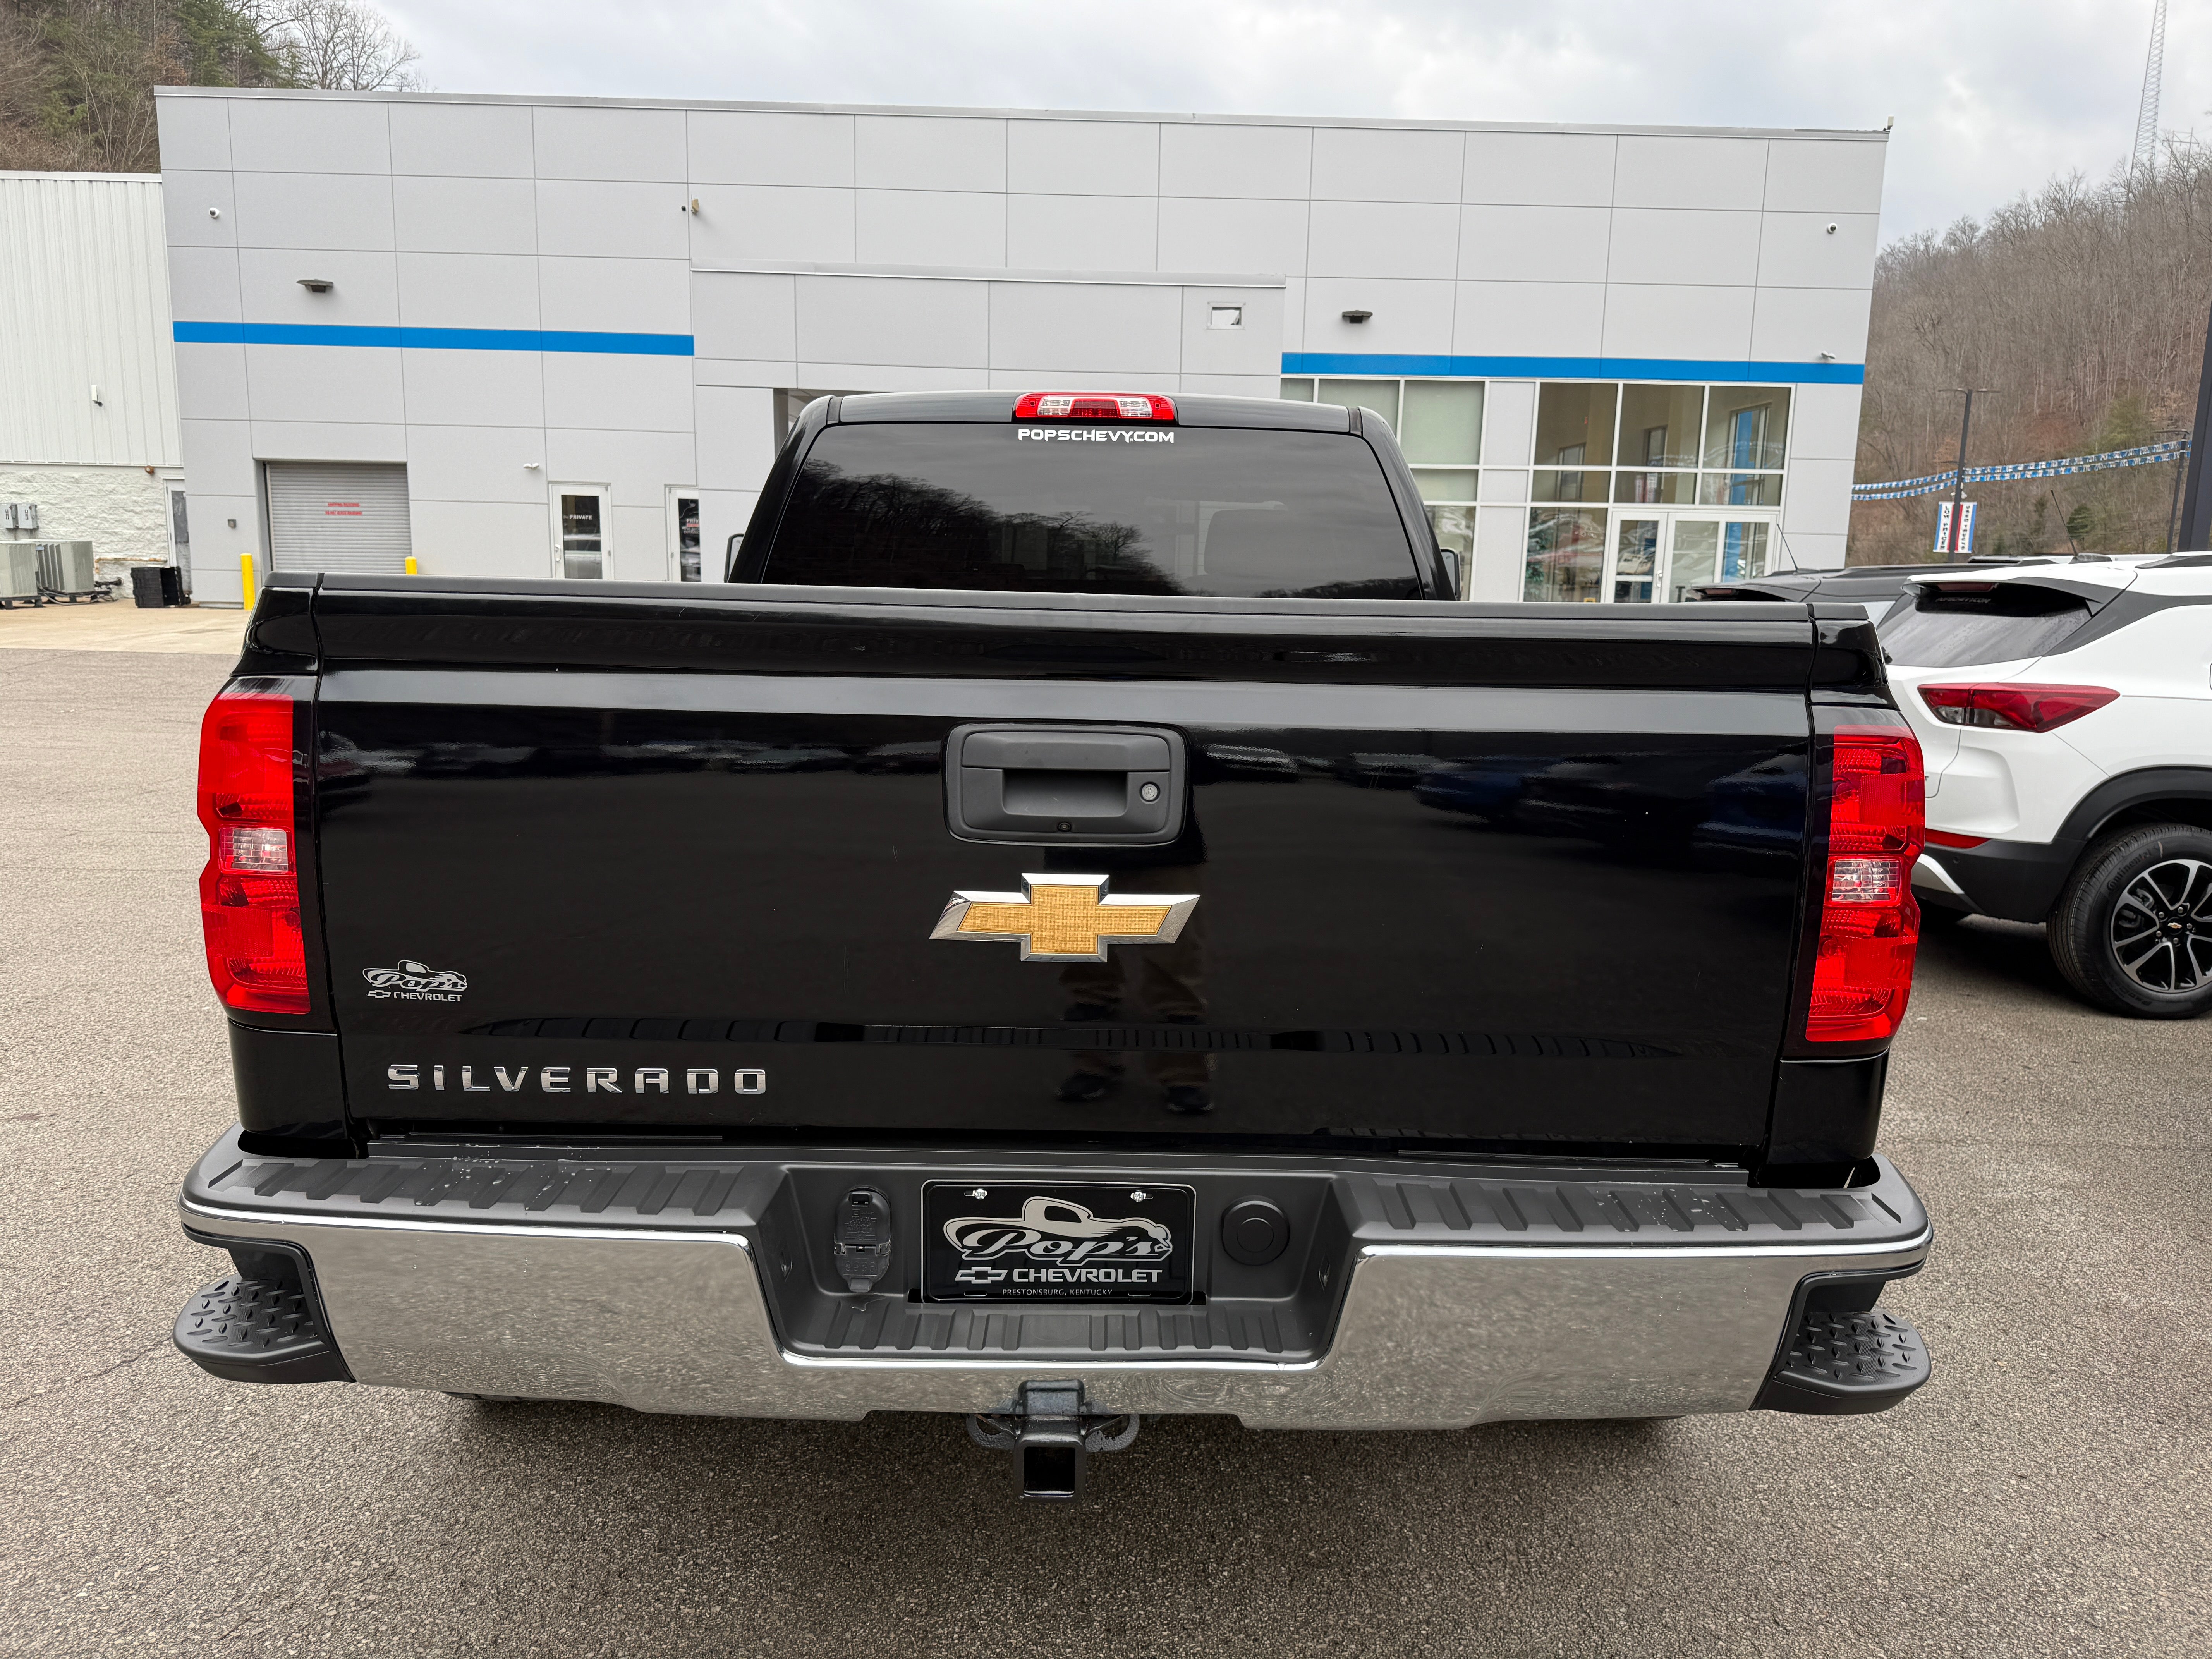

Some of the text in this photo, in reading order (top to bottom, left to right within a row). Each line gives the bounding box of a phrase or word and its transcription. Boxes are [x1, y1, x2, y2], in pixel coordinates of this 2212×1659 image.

[1018, 429, 1174, 444] POPSCHEVY.COM
[2106, 848, 2152, 890] Continental
[393, 991, 462, 1002] CHEVROLET
[387, 1064, 767, 1095] SILVERADO
[962, 1228, 1159, 1261] Pop's
[1013, 1268, 1163, 1283] CHEVROLET
